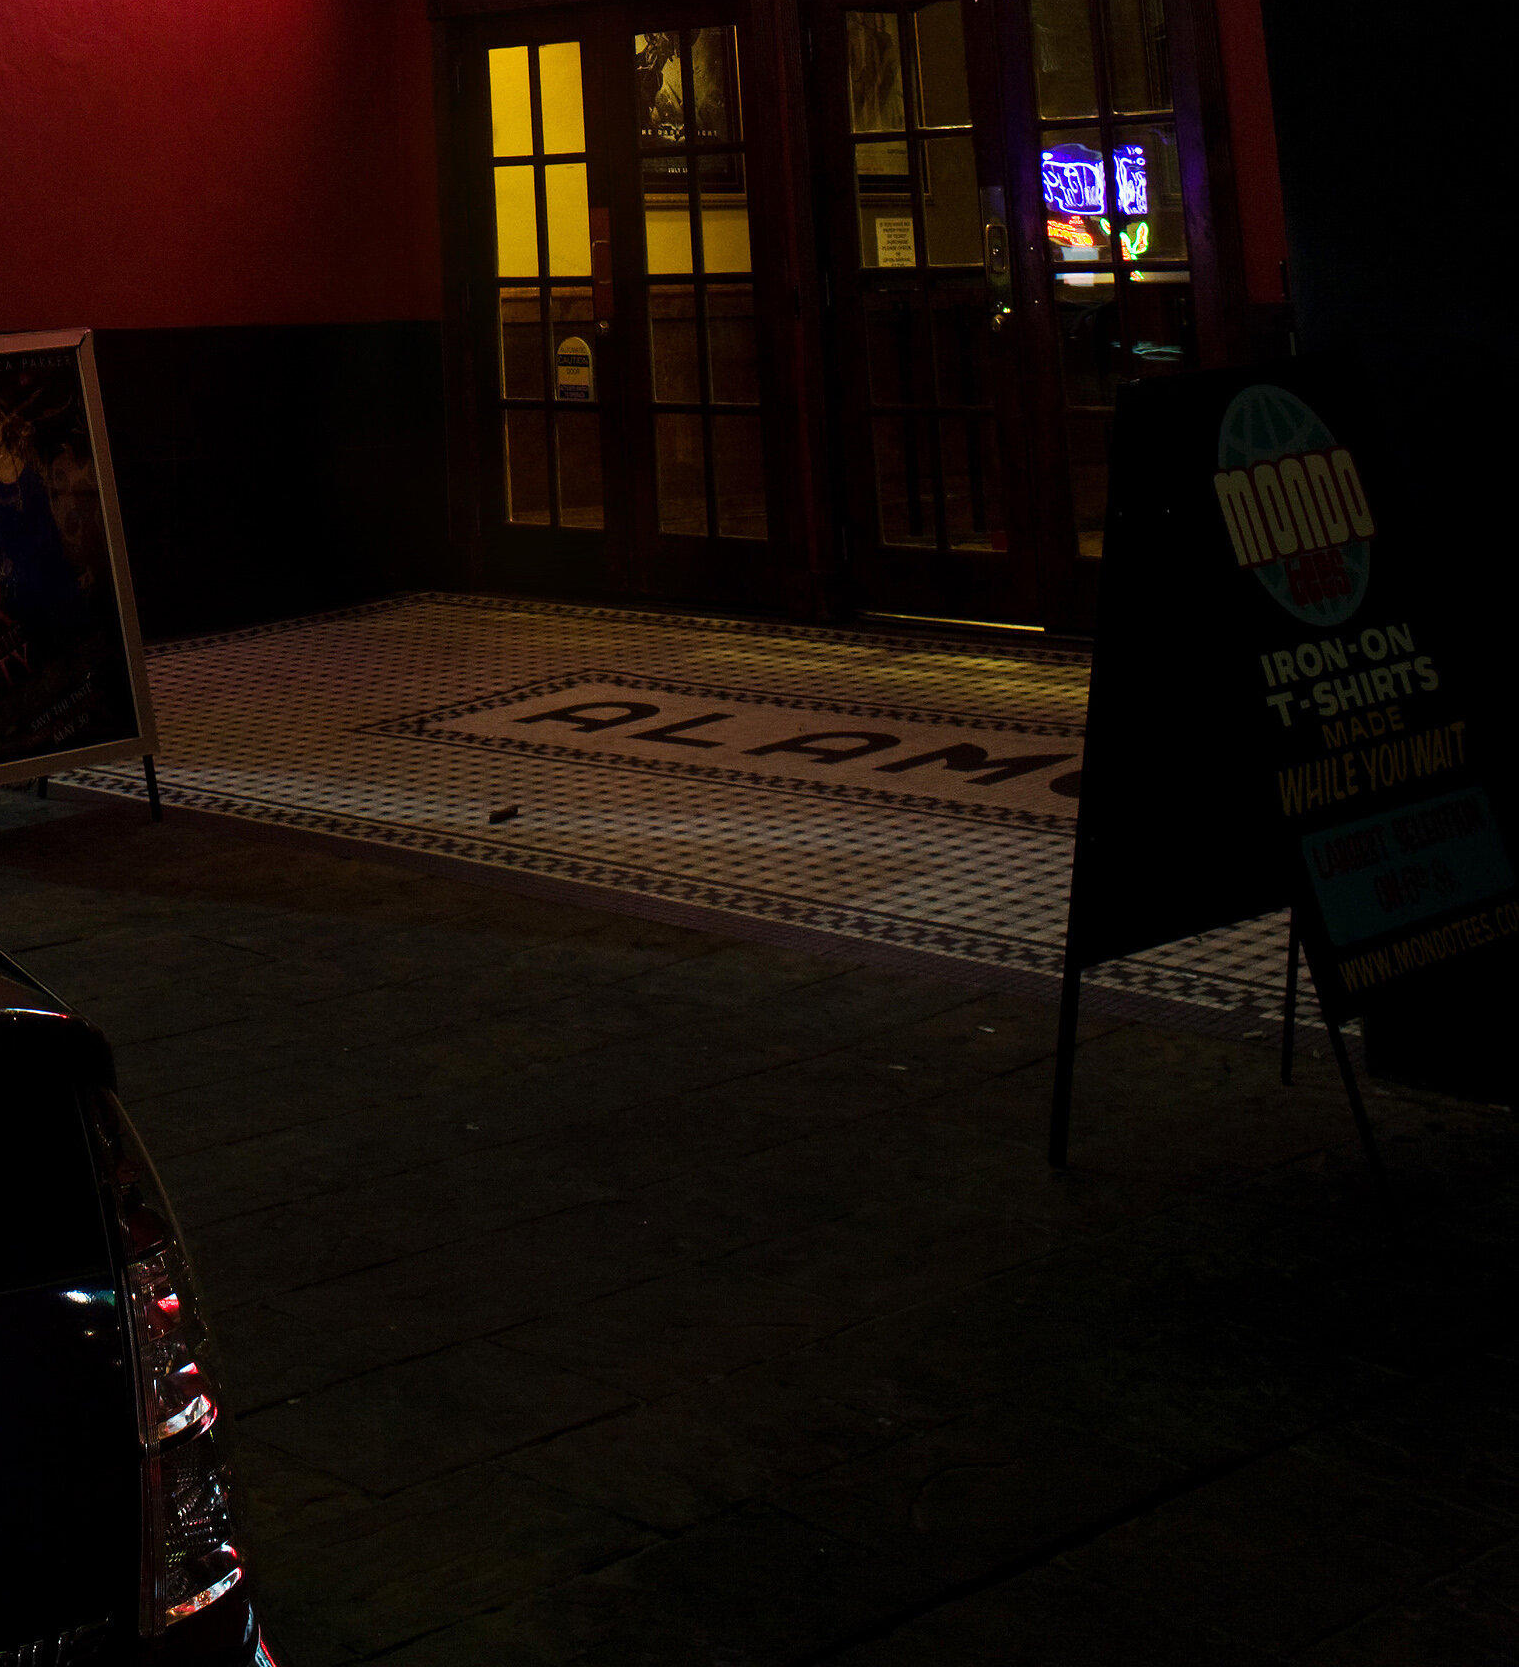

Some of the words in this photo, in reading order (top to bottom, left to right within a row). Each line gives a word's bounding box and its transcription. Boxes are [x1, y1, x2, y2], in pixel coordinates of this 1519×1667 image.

[22, 354, 72, 368] PARKER
[1213, 445, 1377, 569] MONDO
[1260, 622, 1417, 688] IRON-ON
[1266, 656, 1441, 728] T-SHIRTS
[1321, 705, 1406, 750] MADE
[1278, 751, 1360, 817] WHILE
[1360, 739, 1409, 793] YOU
[1408, 720, 1466, 779] WAIT
